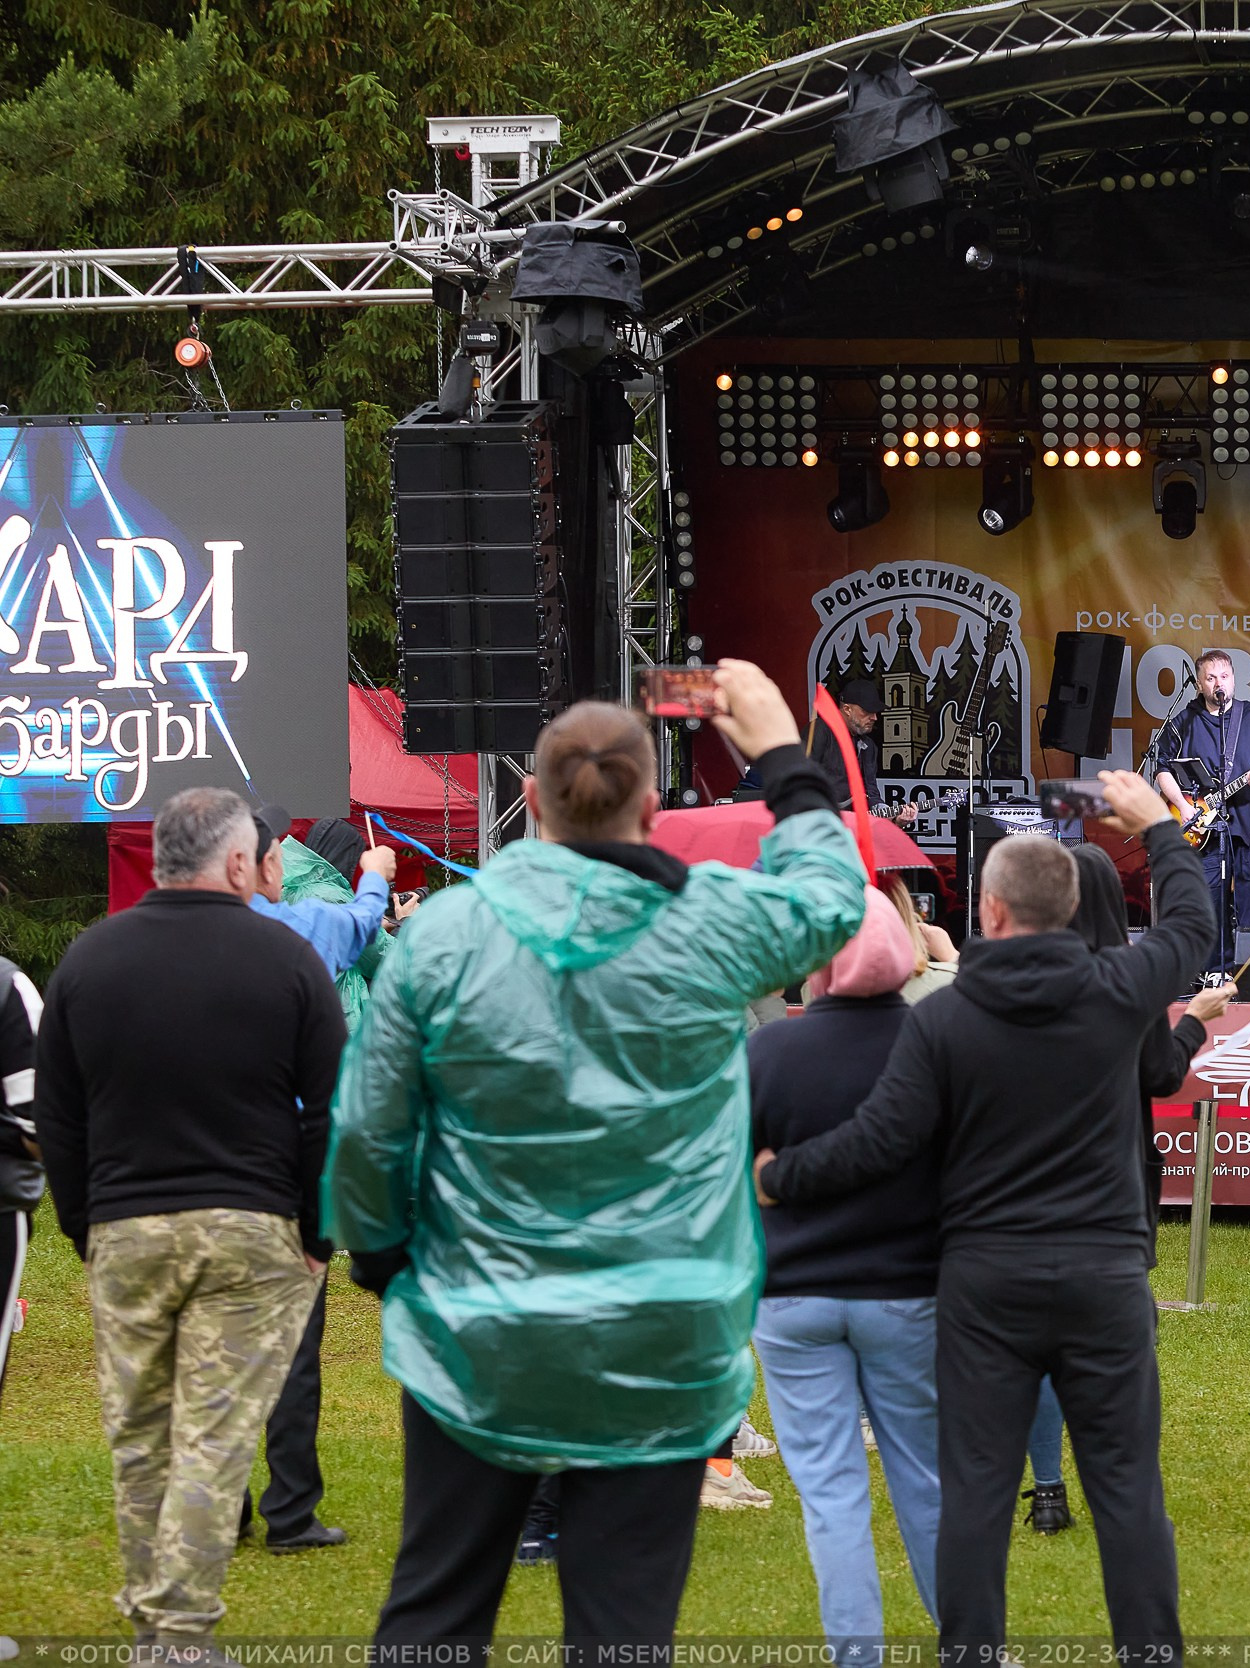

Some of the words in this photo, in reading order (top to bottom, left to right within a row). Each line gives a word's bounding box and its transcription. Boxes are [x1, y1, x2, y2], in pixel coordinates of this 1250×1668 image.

[469, 126, 499, 134] TECH
[502, 125, 532, 133] TEAM
[820, 567, 1014, 619] РОК-ФЕСТИВАЛЬ
